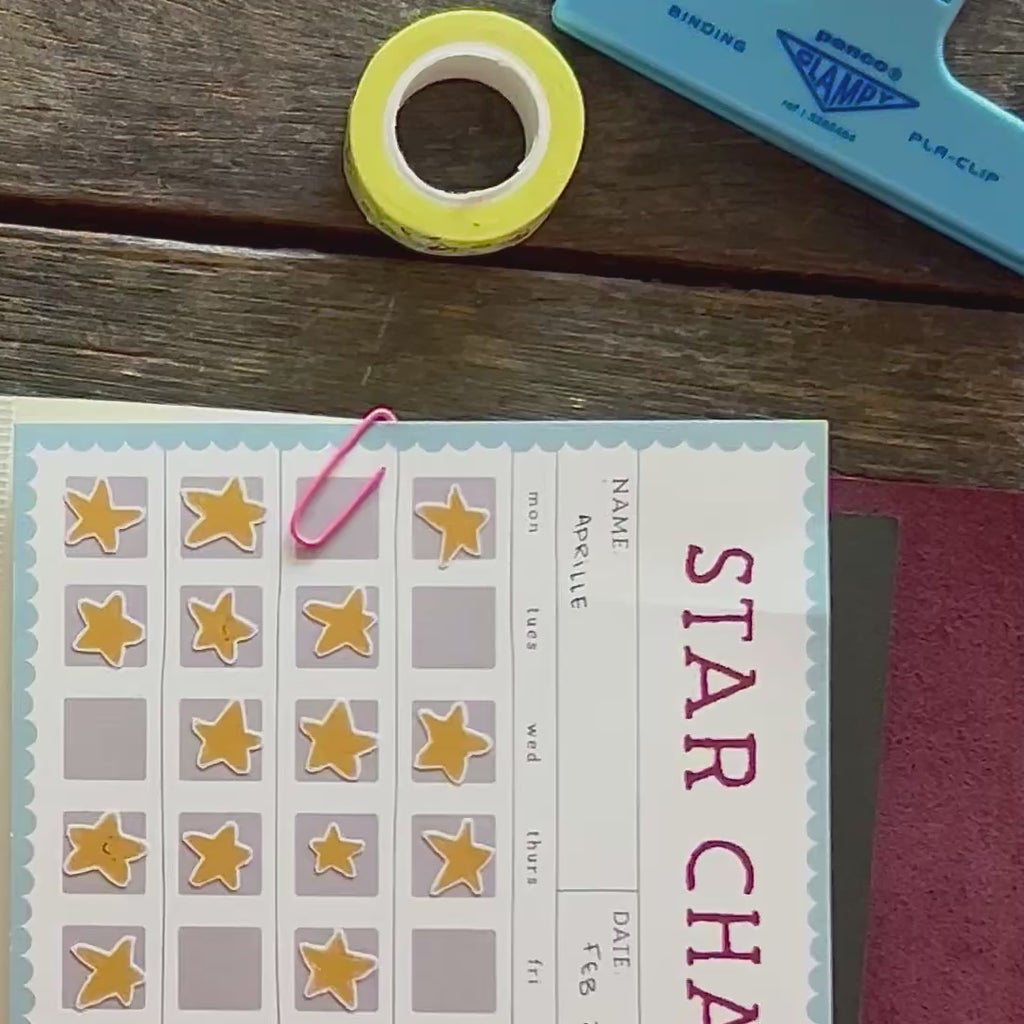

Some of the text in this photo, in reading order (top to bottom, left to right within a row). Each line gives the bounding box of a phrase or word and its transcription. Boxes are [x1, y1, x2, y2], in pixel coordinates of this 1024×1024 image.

[667, 4, 747, 54] BINDING
[794, 47, 898, 107] CLAMPY
[907, 130, 1001, 183] PLA-CLIP
[527, 490, 540, 534] mon
[569, 514, 592, 609] APRILLE
[526, 607, 541, 650] tues
[681, 543, 759, 792] STAR
[526, 723, 542, 763] wed
[526, 830, 543, 886] thurs
[527, 959, 544, 985] fri
[578, 941, 602, 997] FEB
